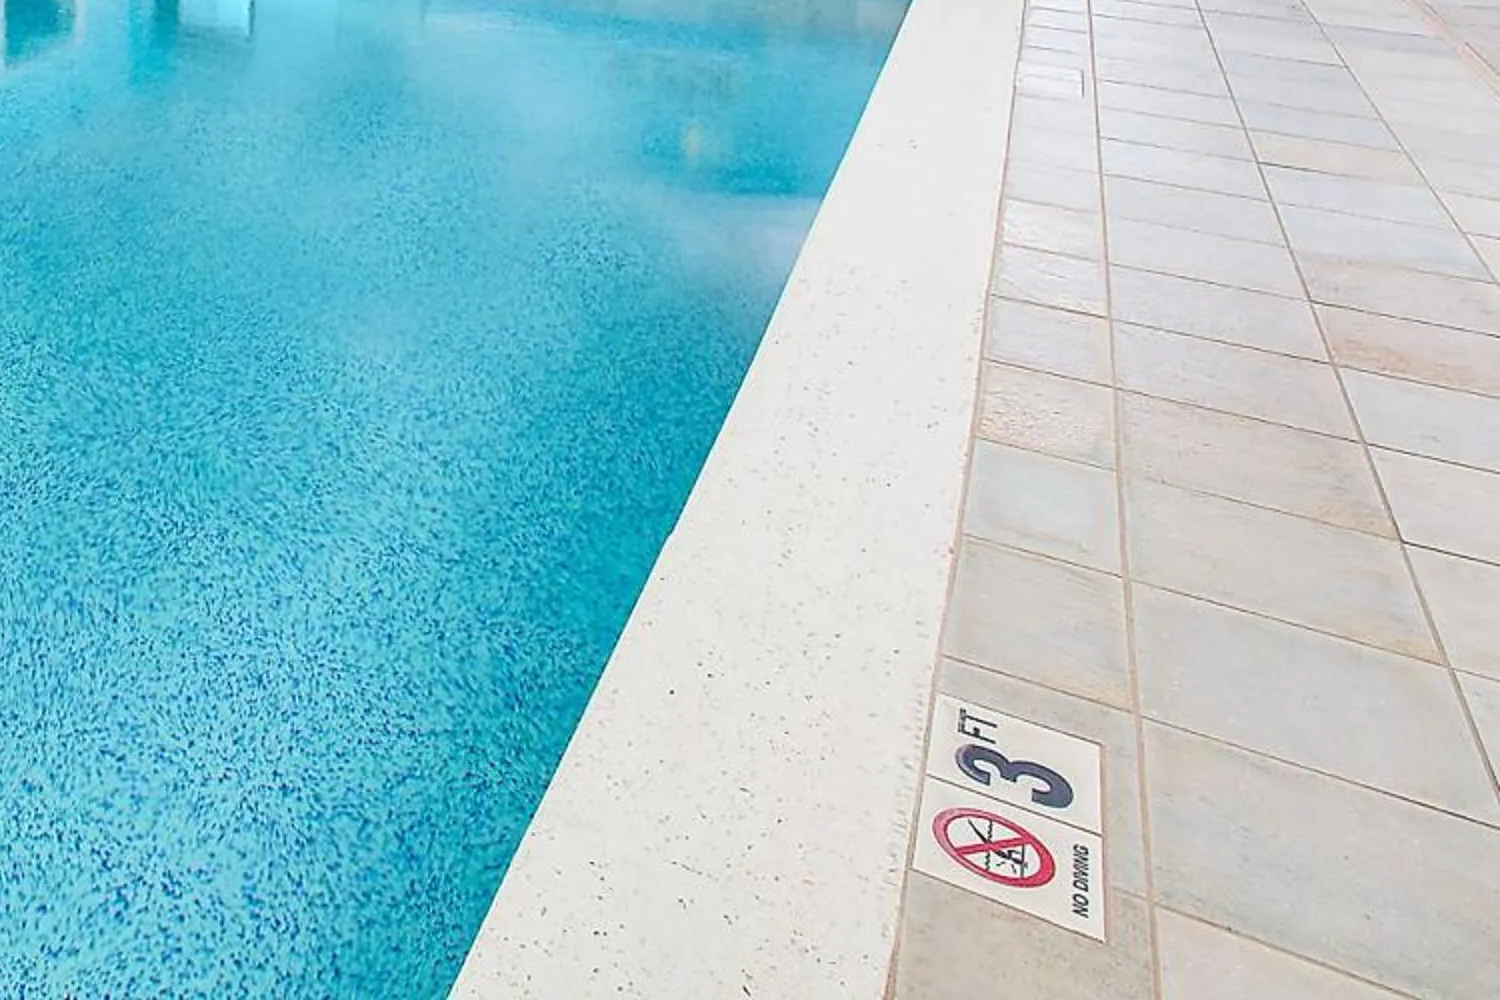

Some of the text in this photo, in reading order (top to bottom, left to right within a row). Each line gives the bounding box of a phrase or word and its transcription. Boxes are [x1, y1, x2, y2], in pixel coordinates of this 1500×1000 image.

[955, 708, 1074, 809] 3 FT
[1072, 844, 1089, 919] NO DIVING
